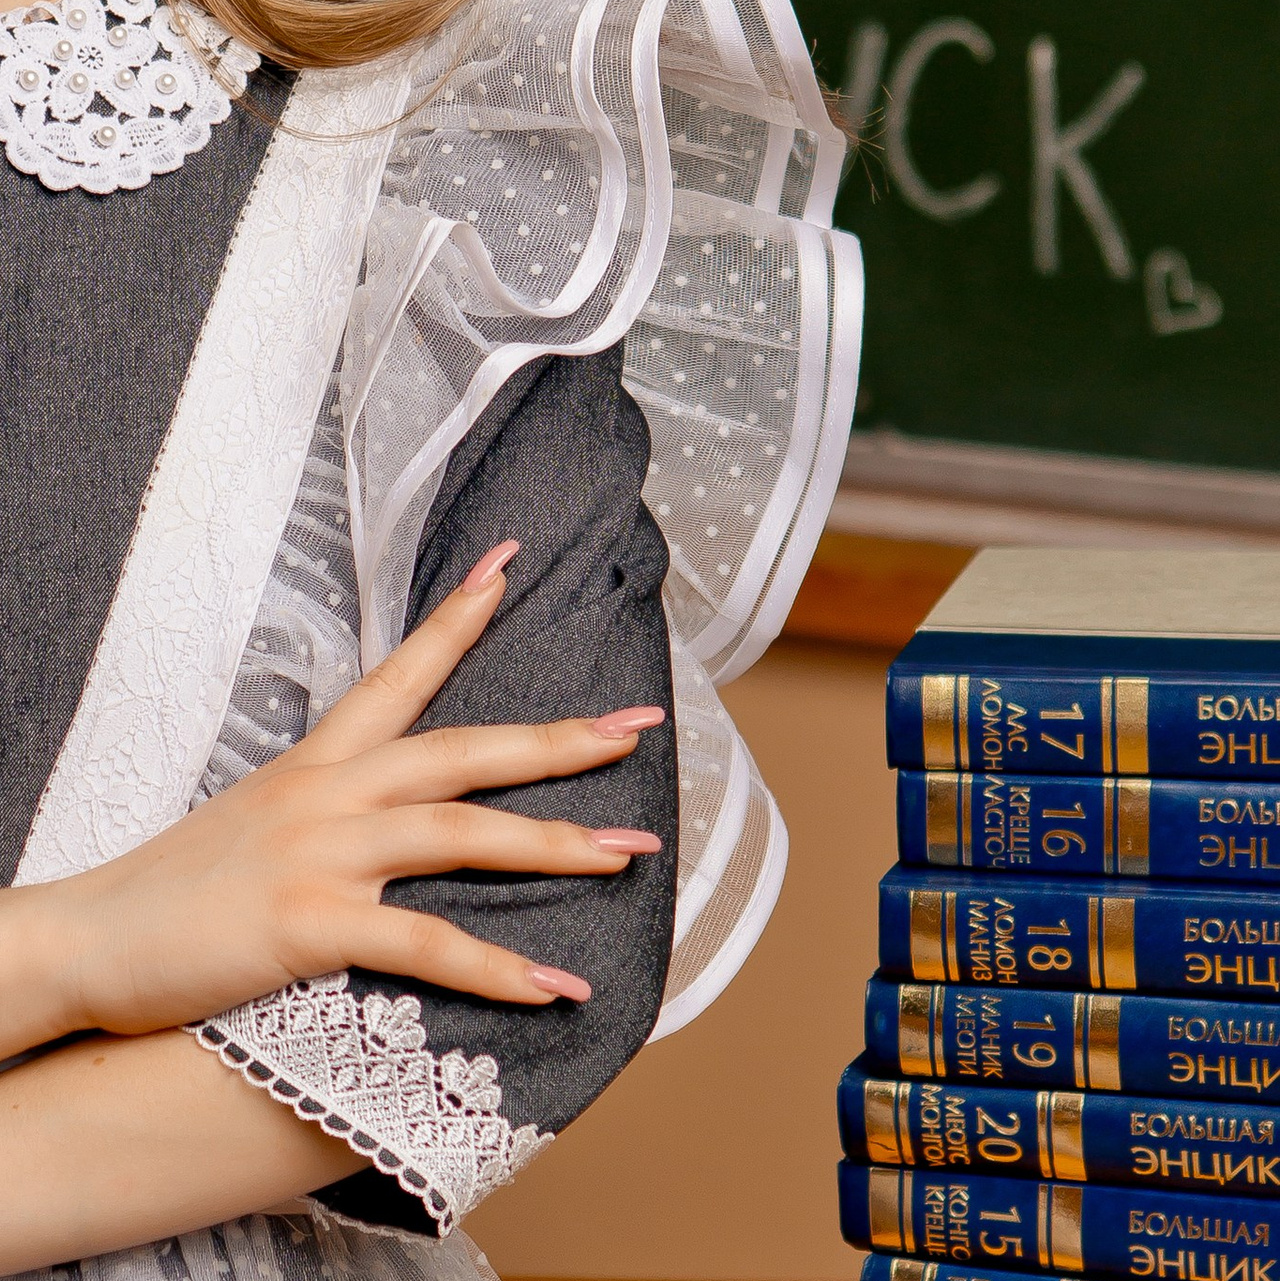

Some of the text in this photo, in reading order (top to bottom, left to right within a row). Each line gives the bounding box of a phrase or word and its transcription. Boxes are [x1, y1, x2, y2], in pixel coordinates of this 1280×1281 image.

[980, 678, 1003, 770] ЛОМОН
[1006, 702, 1028, 752] ЛАС
[1040, 702, 1084, 760] 17
[1042, 802, 1086, 857] 16
[1198, 798, 1280, 826] БОЛЬ
[968, 900, 993, 982] МАНИЗ
[994, 897, 1018, 984] ЛОМОН
[1027, 919, 1072, 971] 18
[956, 993, 978, 1076] МЕОТИ
[981, 994, 1004, 1079] МАНИК
[1013, 1014, 1057, 1068] 19
[976, 1107, 1022, 1162] 20
[1130, 1112, 1274, 1145] БОЛЬШАЯ
[948, 1184, 971, 1260] КОНГО
[979, 1206, 1023, 1257] 15
[1128, 1210, 1270, 1247] БОЛЬШАЯ
